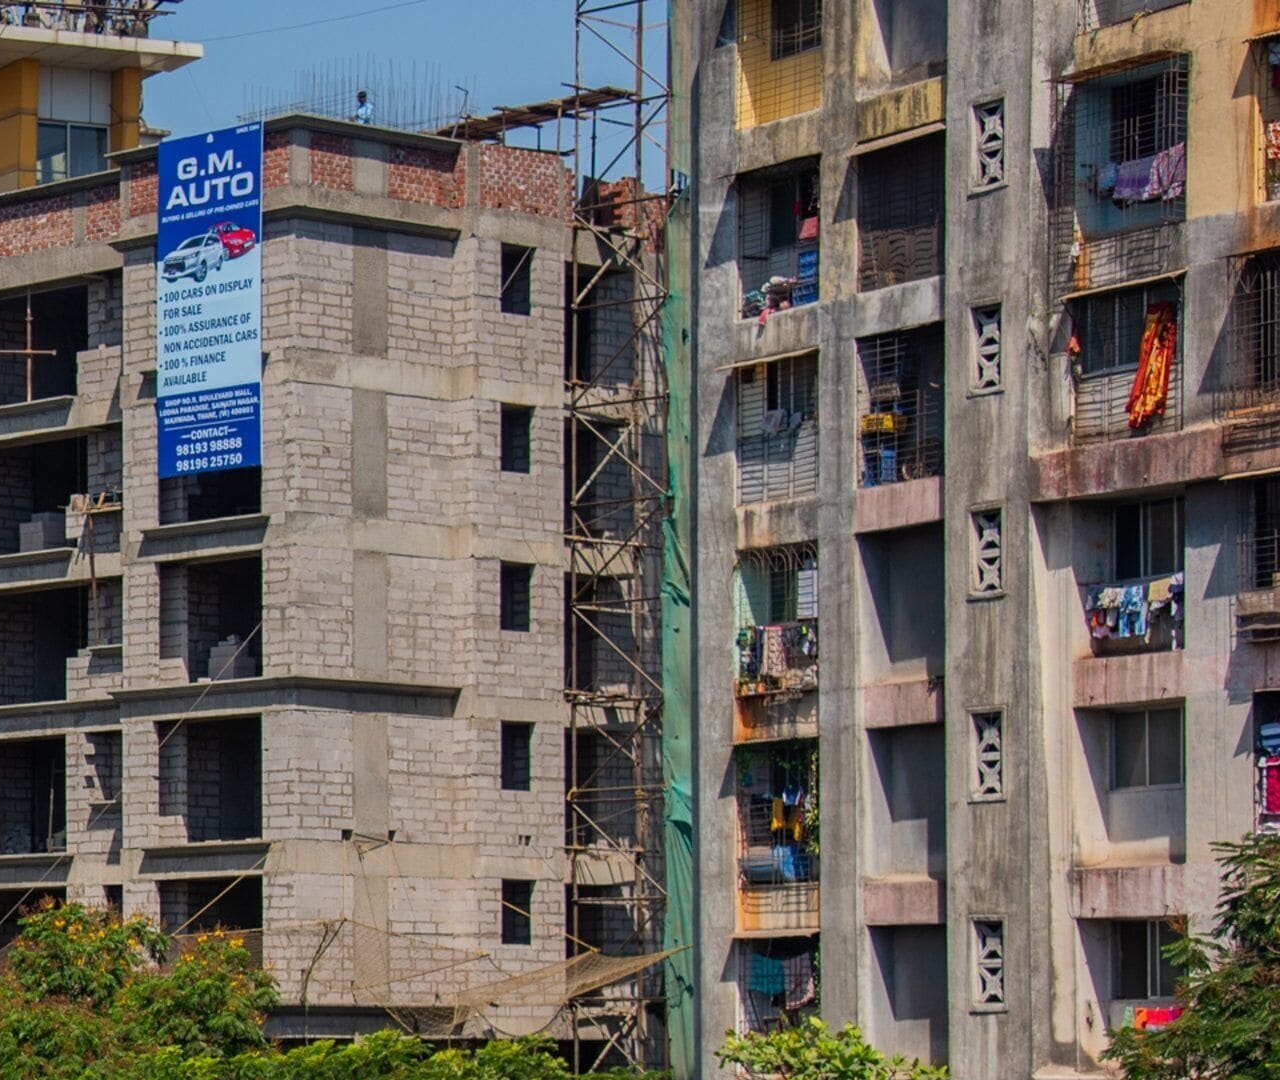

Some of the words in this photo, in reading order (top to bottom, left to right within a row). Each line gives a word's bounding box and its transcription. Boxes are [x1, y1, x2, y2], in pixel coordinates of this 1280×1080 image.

[177, 149, 242, 180] G.M.
[165, 171, 254, 210] AUTO
[162, 214, 180, 223] BUYING
[186, 210, 206, 220] SELLING
[214, 202, 244, 214] PRE-OWNED
[244, 198, 259, 207] CARS
[164, 291, 180, 303] 100
[181, 287, 204, 300] CARS
[205, 285, 217, 296] ON
[219, 278, 254, 294] DISPLAY
[164, 308, 180, 320] FOR
[181, 304, 202, 318] SALE
[164, 324, 186, 337] 100%
[188, 314, 238, 333] ASSURANCE
[240, 312, 252, 324] OF
[164, 342, 182, 354] NON
[183, 333, 234, 350] ACCIDENTAL
[235, 329, 258, 342] CARS
[164, 358, 180, 370] 100
[190, 351, 226, 367] FINANCE
[163, 371, 207, 388] AVAILABLE
[198, 390, 234, 402] BOULEVARD
[176, 442, 208, 456] 98193
[210, 437, 242, 451] 98888
[176, 458, 208, 472] 98196
[210, 453, 242, 468] 25750
